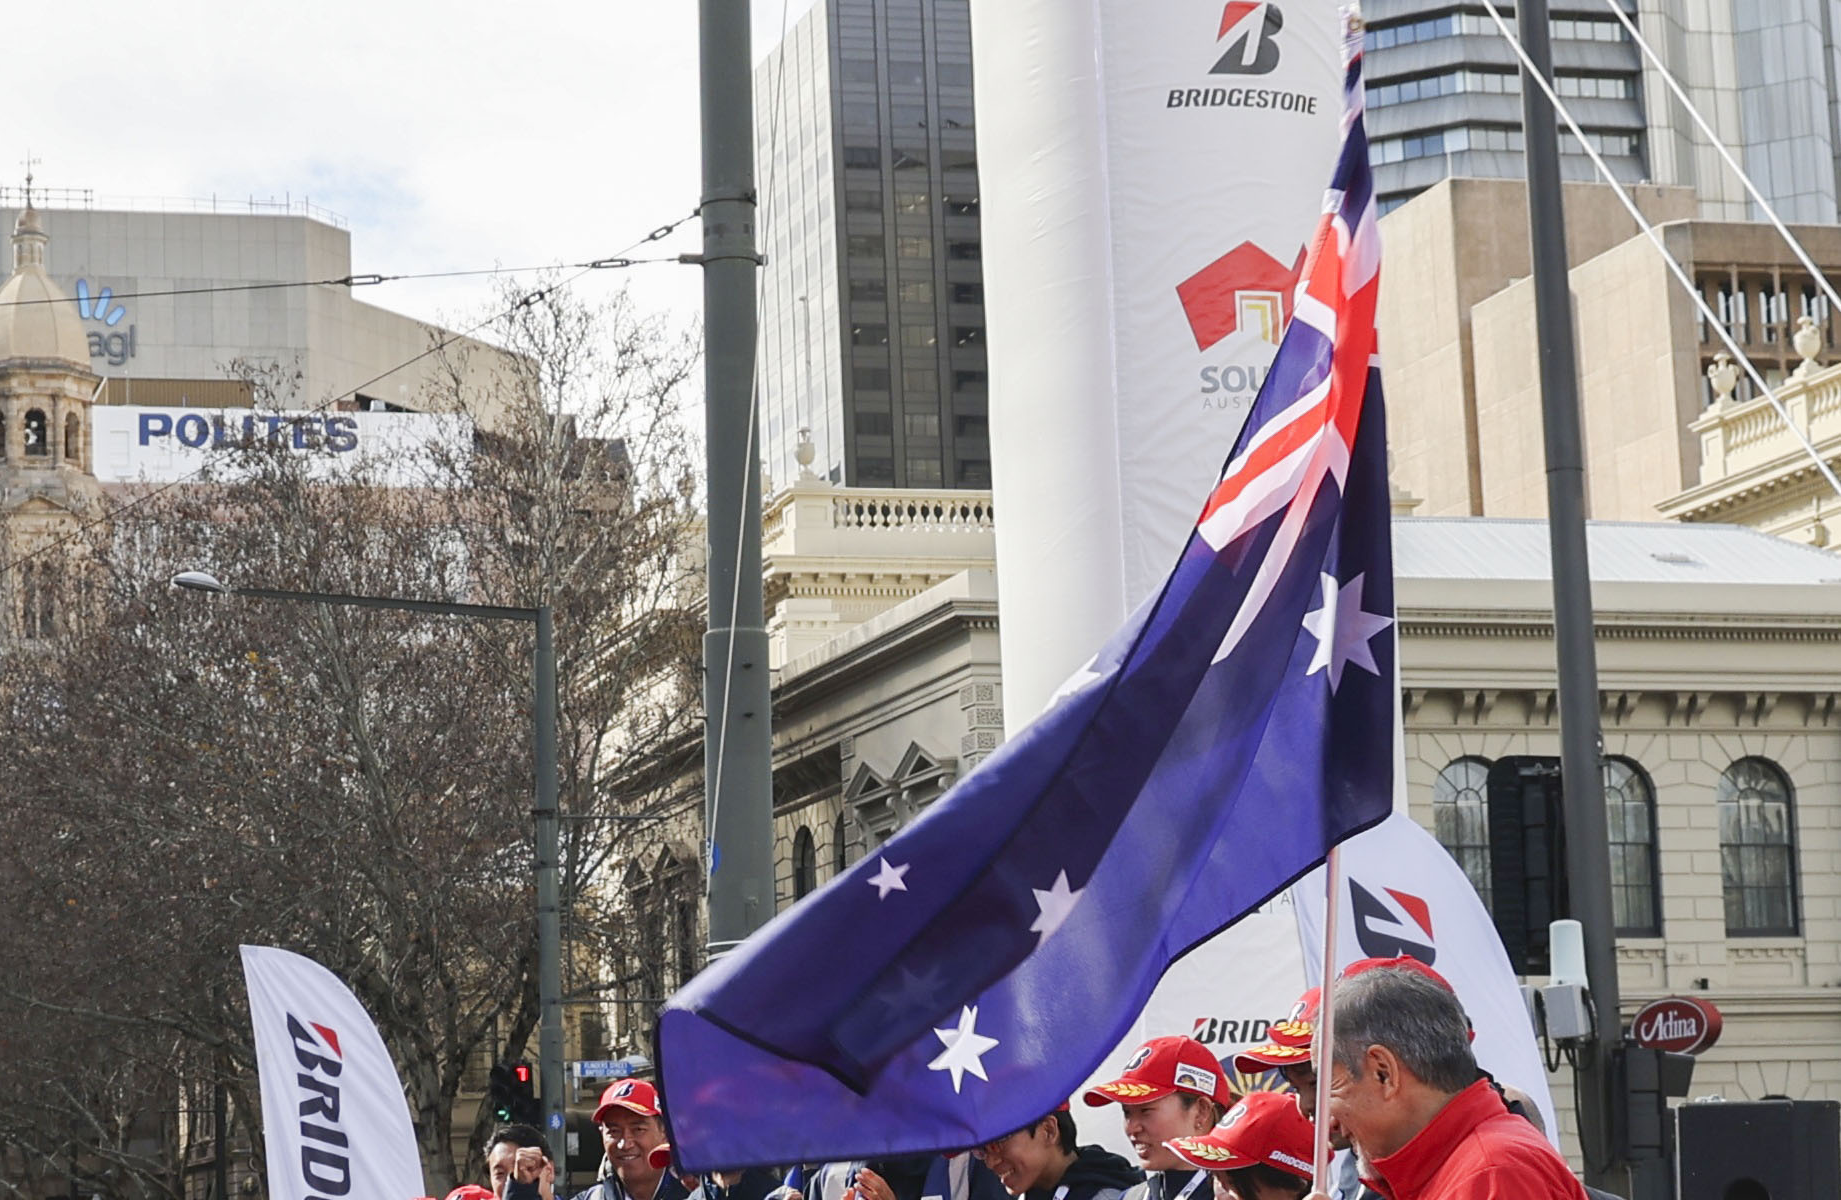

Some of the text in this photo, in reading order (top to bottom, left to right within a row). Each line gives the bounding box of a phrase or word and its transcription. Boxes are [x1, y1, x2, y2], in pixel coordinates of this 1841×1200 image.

[1167, 88, 1317, 115] BRIDGESTONE
[87, 325, 135, 366] agl
[139, 413, 358, 452] POLITES
[1641, 1010, 1697, 1042] Adina
